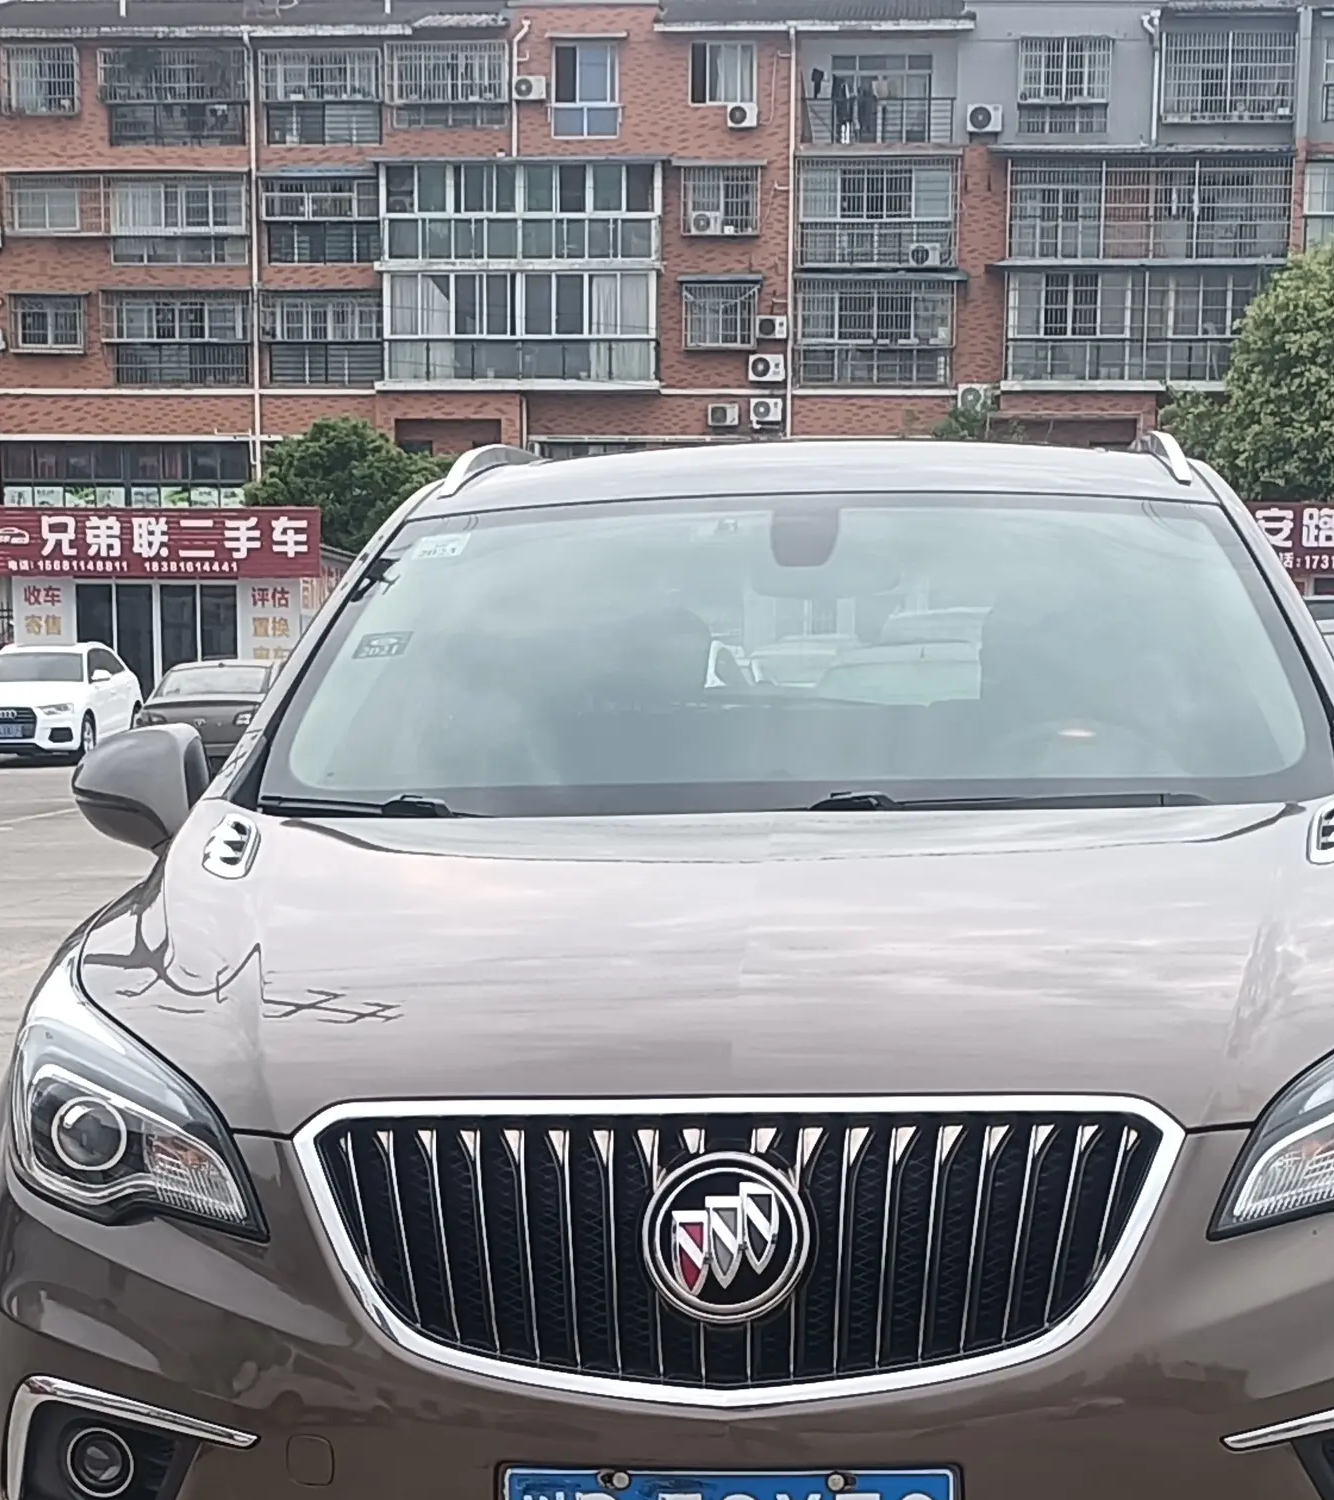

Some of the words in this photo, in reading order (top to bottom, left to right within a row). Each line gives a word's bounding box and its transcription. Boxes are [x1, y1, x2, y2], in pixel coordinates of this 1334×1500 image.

[41, 516, 308, 557] 兄弟联二手车
[24, 585, 61, 606] 收车
[252, 587, 289, 608] 评估
[24, 616, 61, 636] 寄售
[252, 616, 290, 637] 置换
